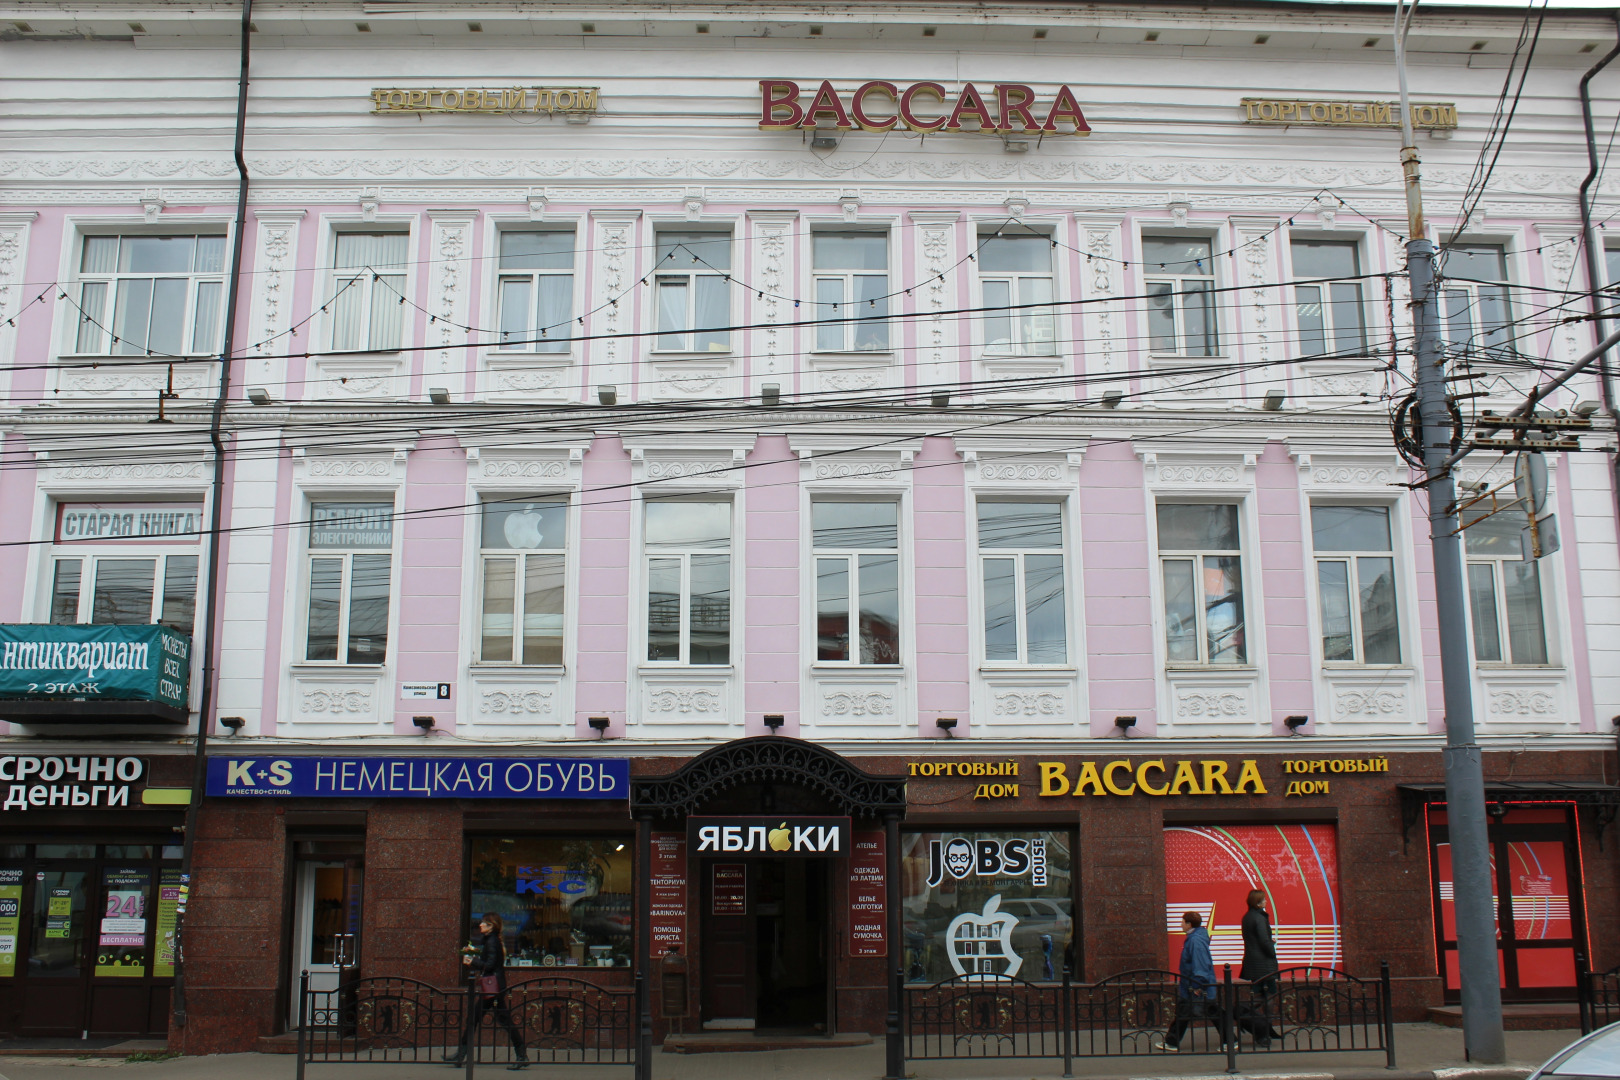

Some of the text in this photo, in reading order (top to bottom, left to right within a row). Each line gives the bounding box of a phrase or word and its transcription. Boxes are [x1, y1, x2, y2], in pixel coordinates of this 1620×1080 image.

[373, 86, 598, 112] ТОРГОВЫЙ ДОМ
[758, 79, 1093, 136] BACCARA
[1243, 100, 1391, 124] ТОРГОВЫЙ
[65, 512, 195, 536] СТАРАЯ КНИГА
[313, 508, 393, 530] РЕМОНТ
[312, 532, 392, 545] ЭЛЕКТРОНИКИ
[161, 633, 188, 660] МОНЕТЫ
[164, 657, 181, 679] ВСЕХ
[27, 682, 101, 694] 2 ЭТАЖ
[160, 678, 182, 700] СТРАН
[440, 685, 448, 697] 8
[0, 756, 143, 781] СРОЧНО
[227, 760, 293, 786] K+S
[908, 759, 1019, 776] ТОРГОВЫЙ
[1282, 755, 1389, 773] ТОРГОВЫЙ
[315, 761, 616, 796] НЕМЕЦКАЯ ОБУВЬ
[1038, 758, 1268, 797] BACCARA
[1285, 780, 1330, 797] ДОМ
[3, 784, 129, 811] деньги
[973, 783, 1019, 801] ДОМ
[1032, 838, 1048, 887] HOUSE
[105, 895, 137, 917] 24
